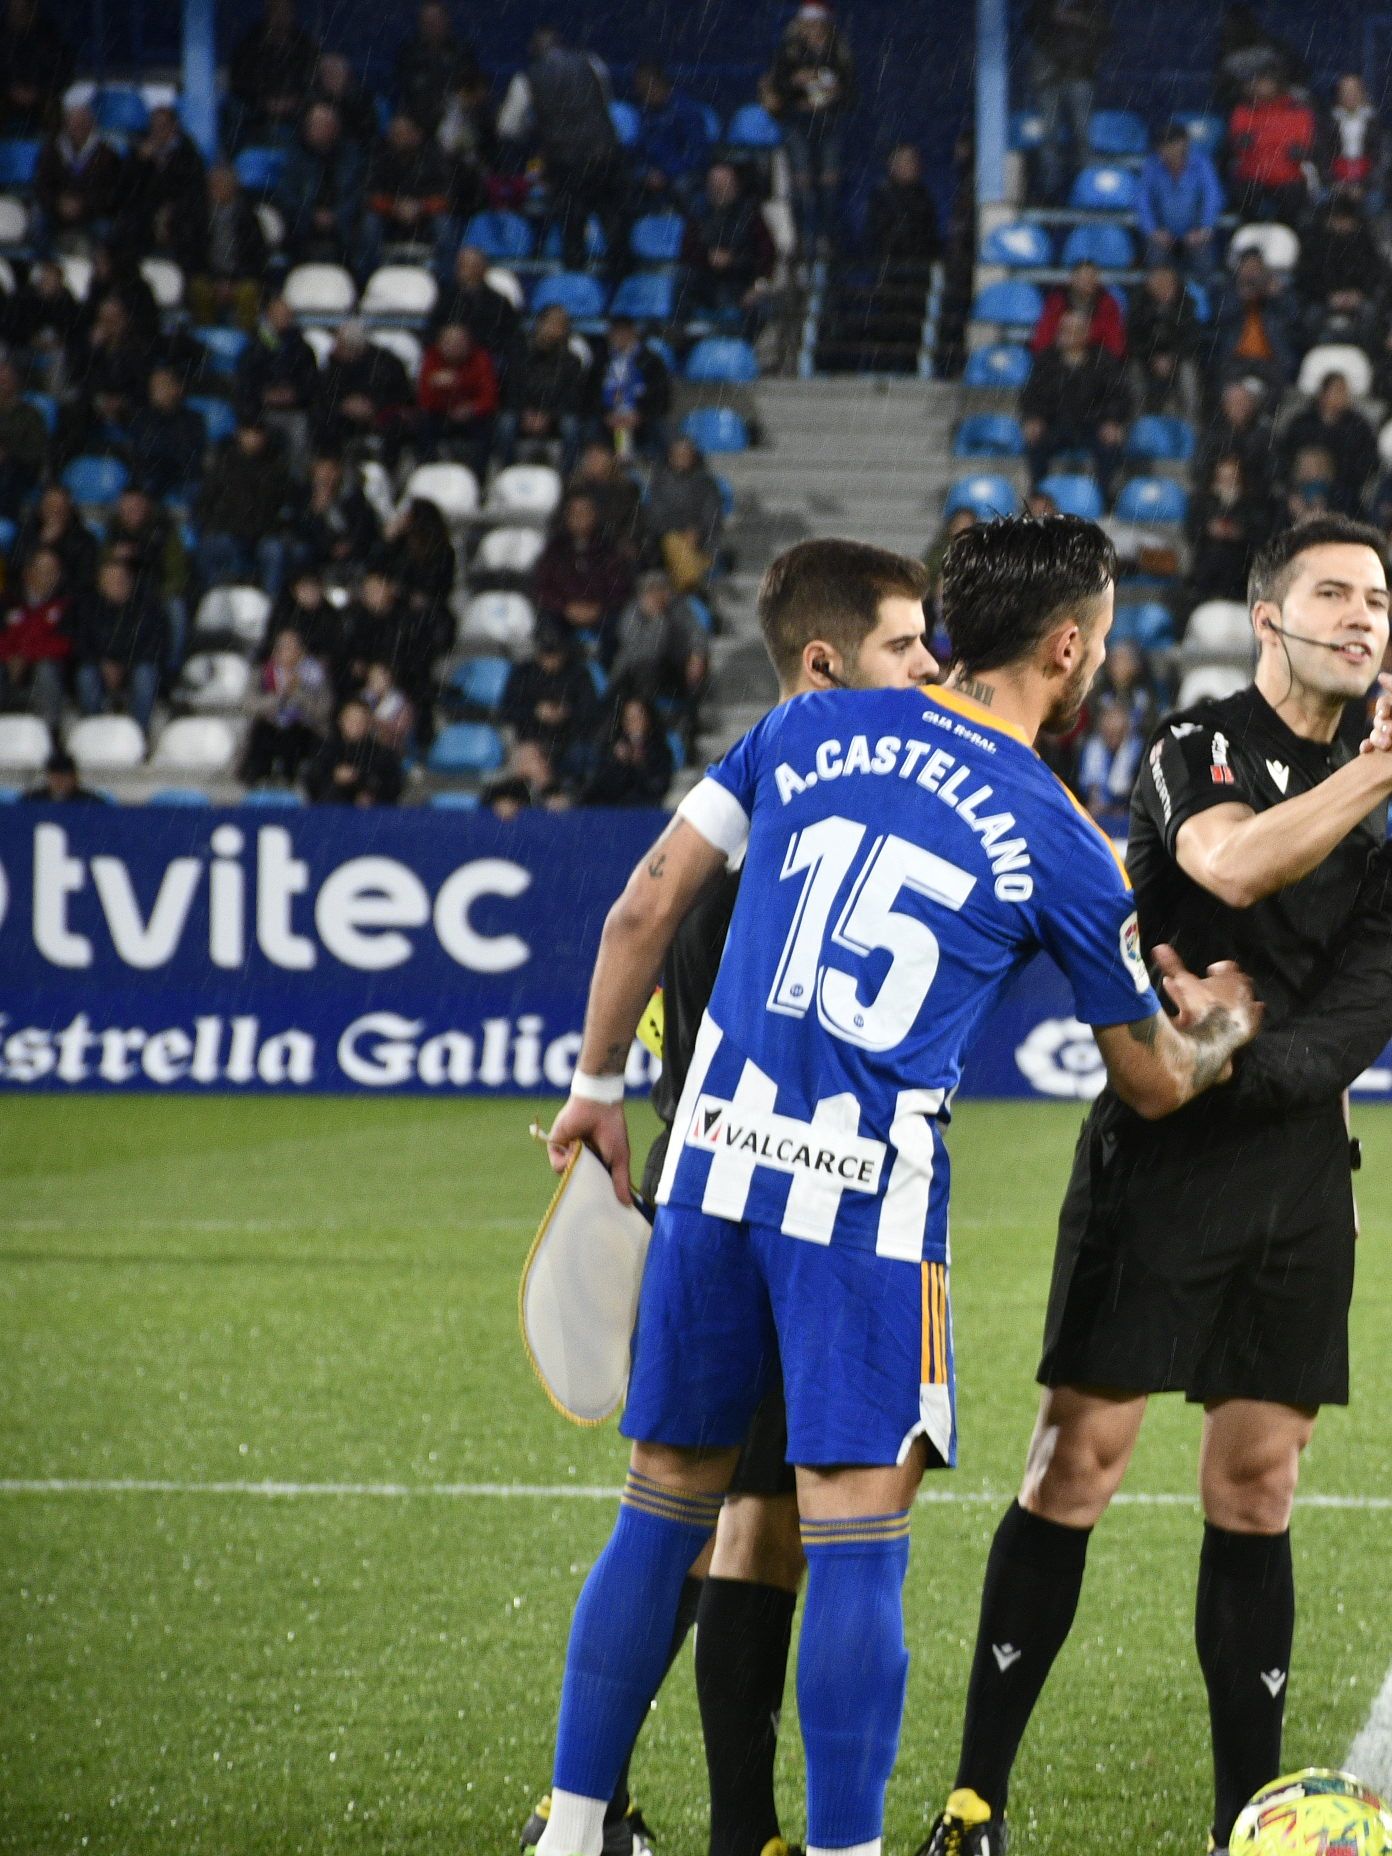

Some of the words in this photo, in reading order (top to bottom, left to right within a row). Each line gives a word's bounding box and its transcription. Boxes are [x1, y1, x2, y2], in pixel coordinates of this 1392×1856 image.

[774, 734, 1033, 903] A.CASTELLANO
[33, 822, 533, 973] tvitec
[766, 815, 977, 1052] 15
[0, 1014, 314, 1085] strella
[338, 1012, 663, 1088] Galica
[726, 1122, 875, 1184] VALCARCE
